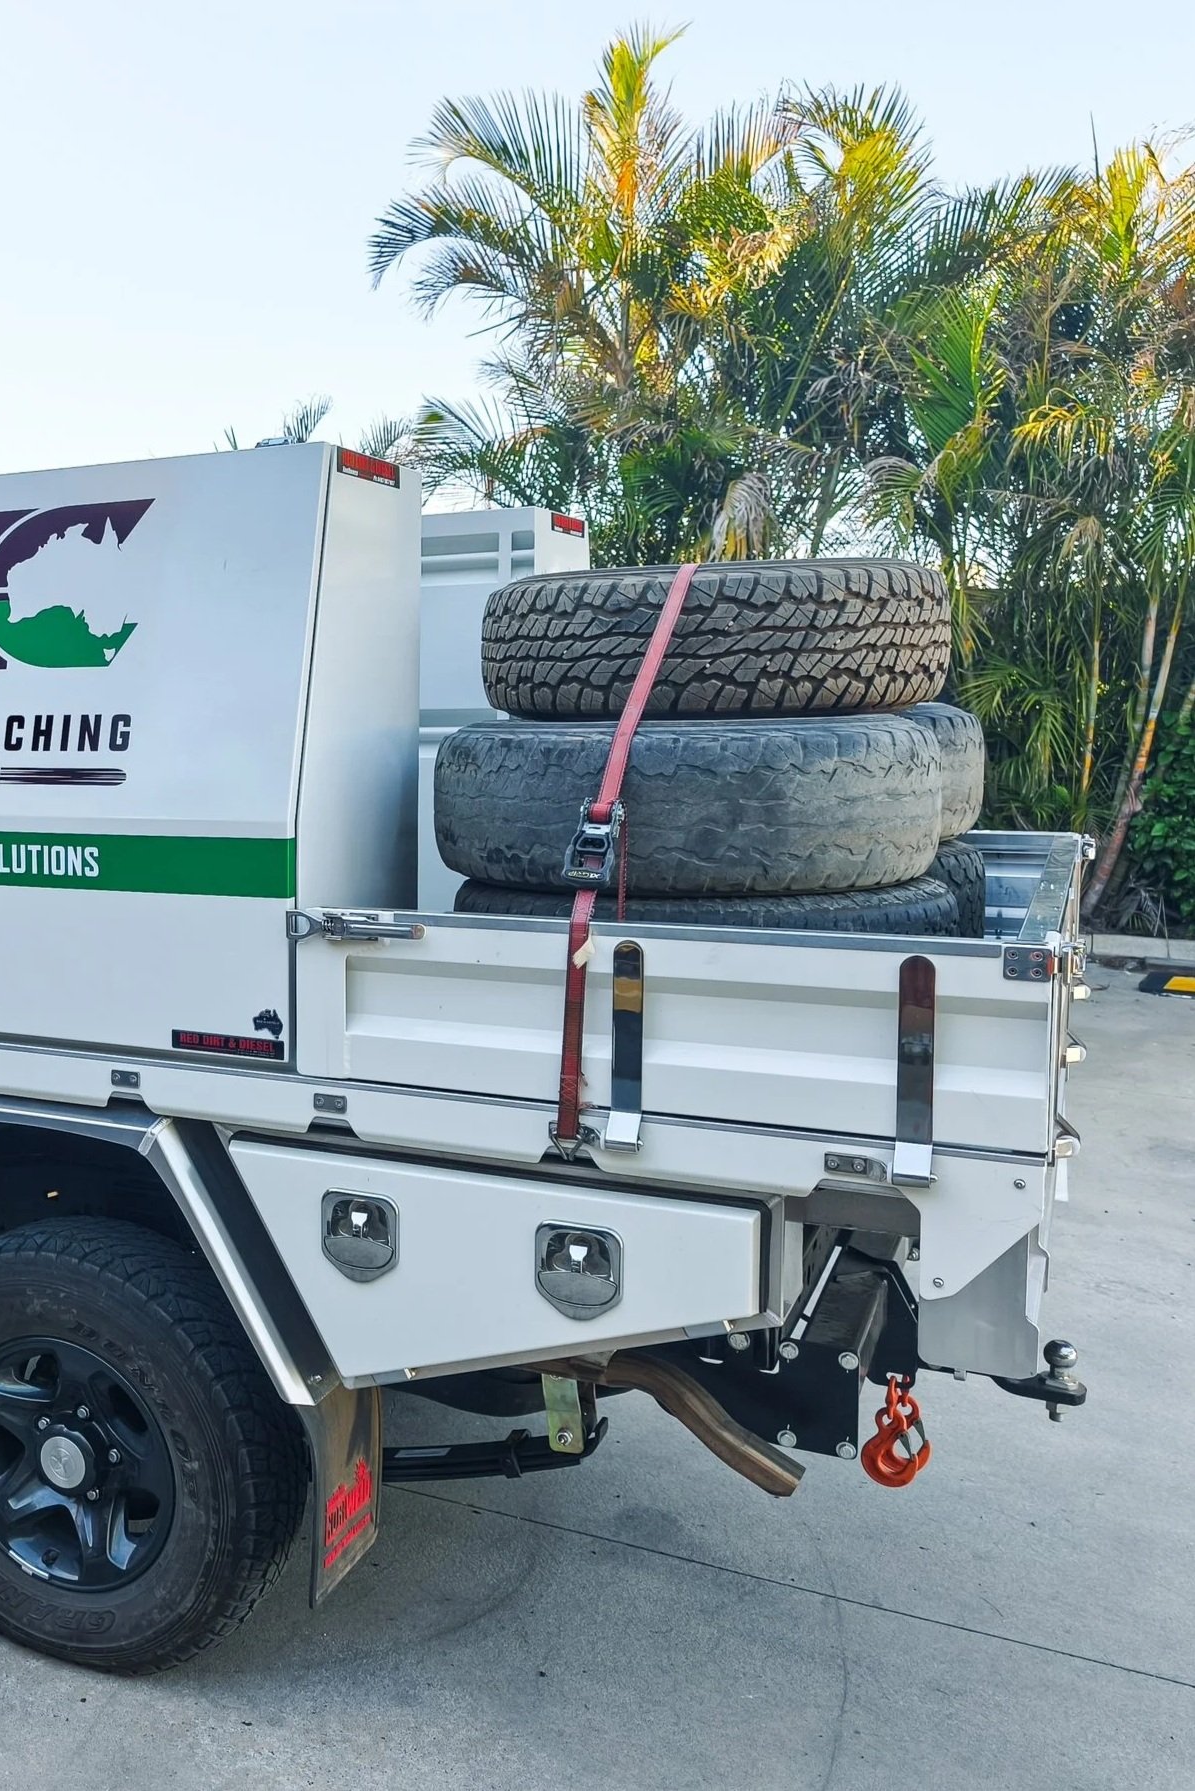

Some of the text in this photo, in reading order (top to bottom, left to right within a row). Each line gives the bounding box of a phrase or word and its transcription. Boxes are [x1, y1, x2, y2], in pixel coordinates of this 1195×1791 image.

[180, 1032, 275, 1052] RED DIRT & DIESEL
